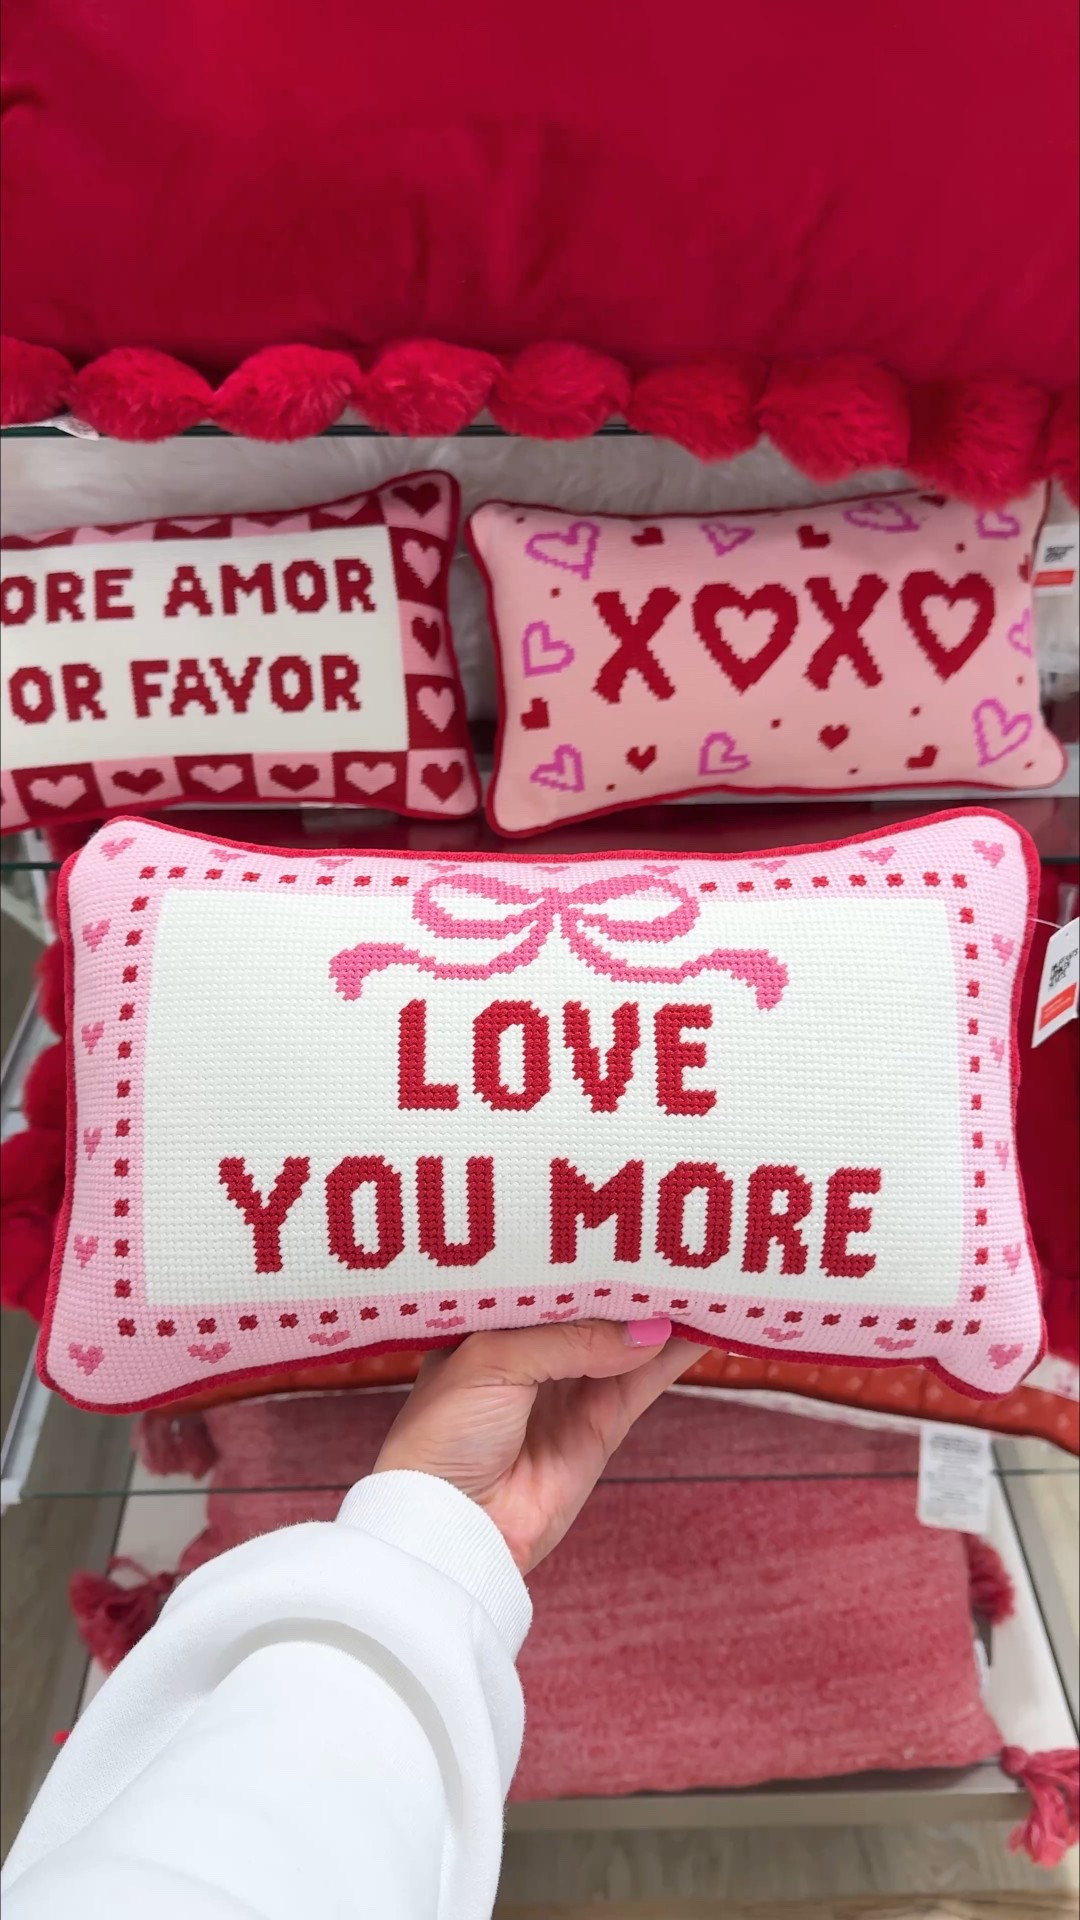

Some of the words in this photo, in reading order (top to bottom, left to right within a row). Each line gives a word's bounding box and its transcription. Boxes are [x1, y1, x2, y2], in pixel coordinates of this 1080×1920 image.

[164, 558, 376, 616] AMOR
[130, 654, 362, 719] FAVOR
[399, 998, 718, 1116] LOVE
[219, 1155, 496, 1273] YOU
[551, 1158, 882, 1278] MORE
